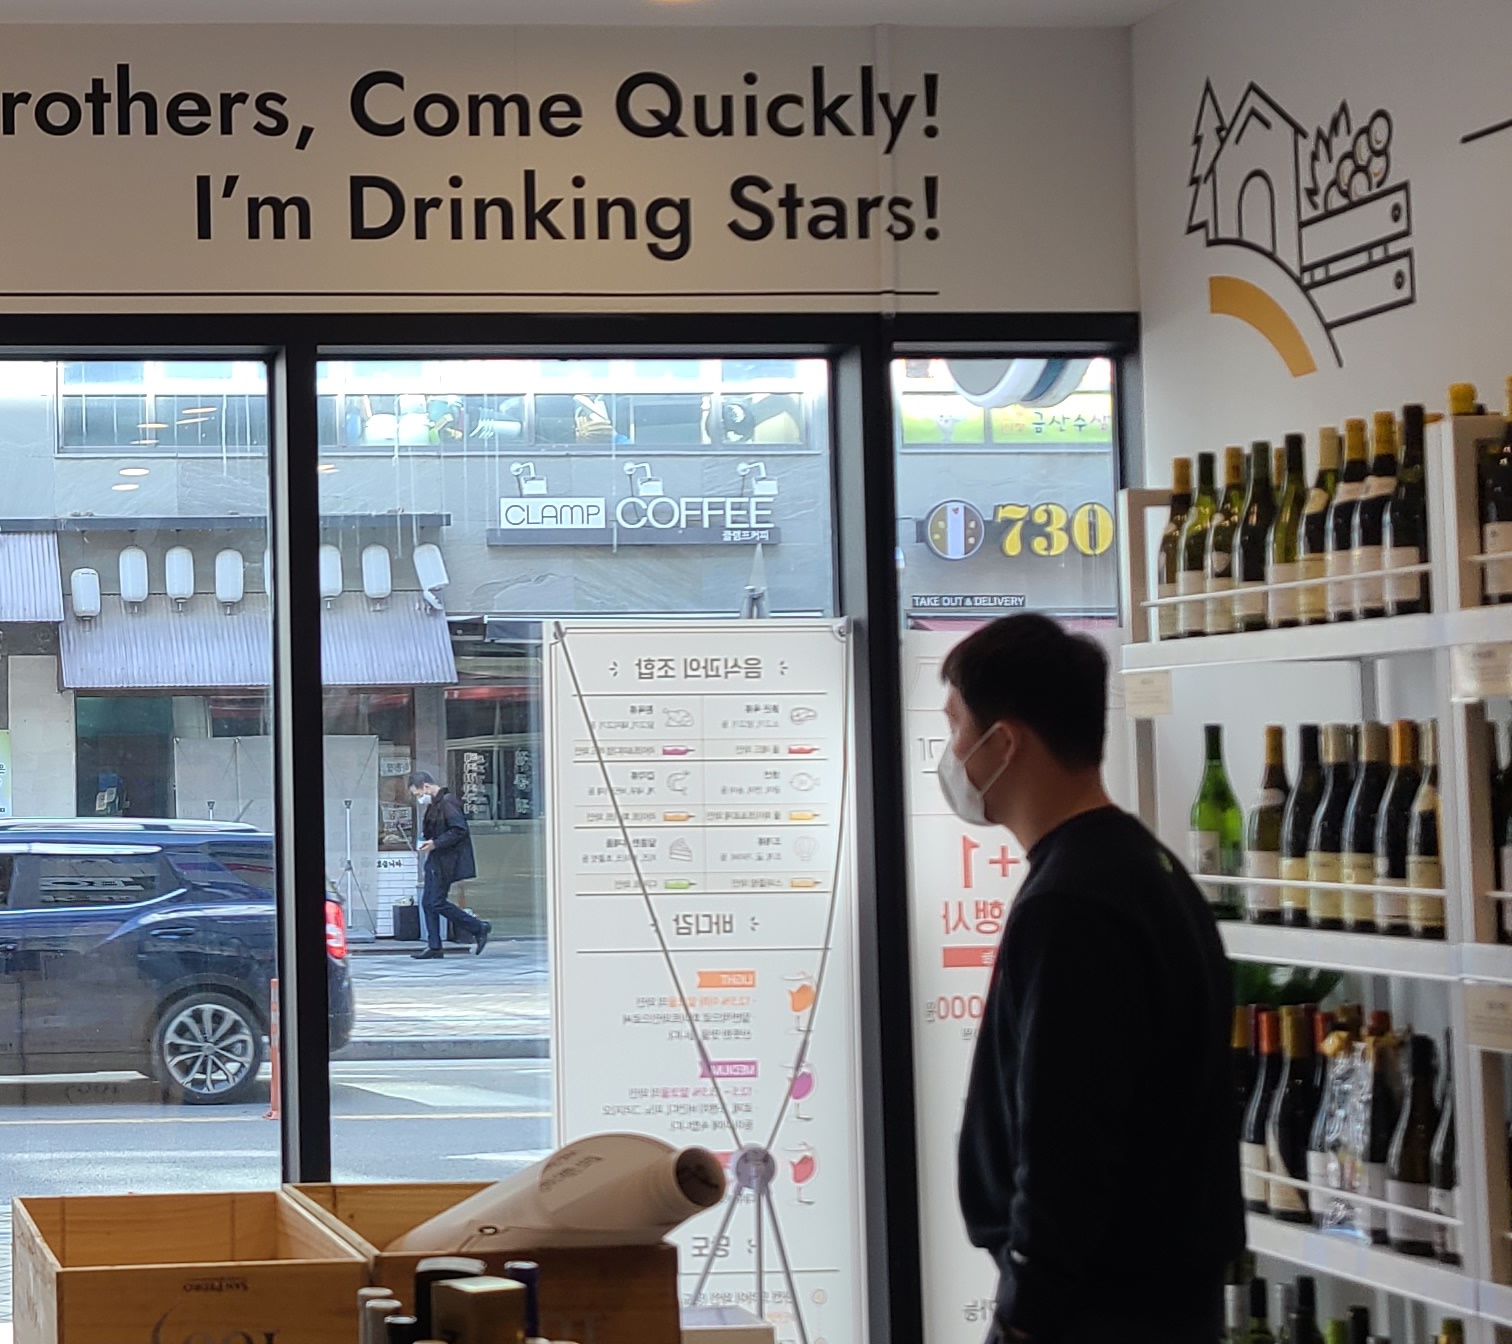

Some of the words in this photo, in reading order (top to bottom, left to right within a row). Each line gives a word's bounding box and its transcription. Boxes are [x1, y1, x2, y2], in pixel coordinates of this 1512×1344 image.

[349, 71, 584, 139] Come
[615, 64, 941, 154] Quickly!
[195, 173, 312, 240] I'm
[349, 170, 692, 261] Drinking
[727, 174, 941, 242] Stars!
[504, 504, 601, 526] CLAMP
[615, 497, 775, 528] COFFEE
[994, 502, 1115, 557] 730
[912, 596, 940, 607] TAKE
[941, 596, 964, 607] OUT
[974, 596, 1025, 607] DELIVERY
